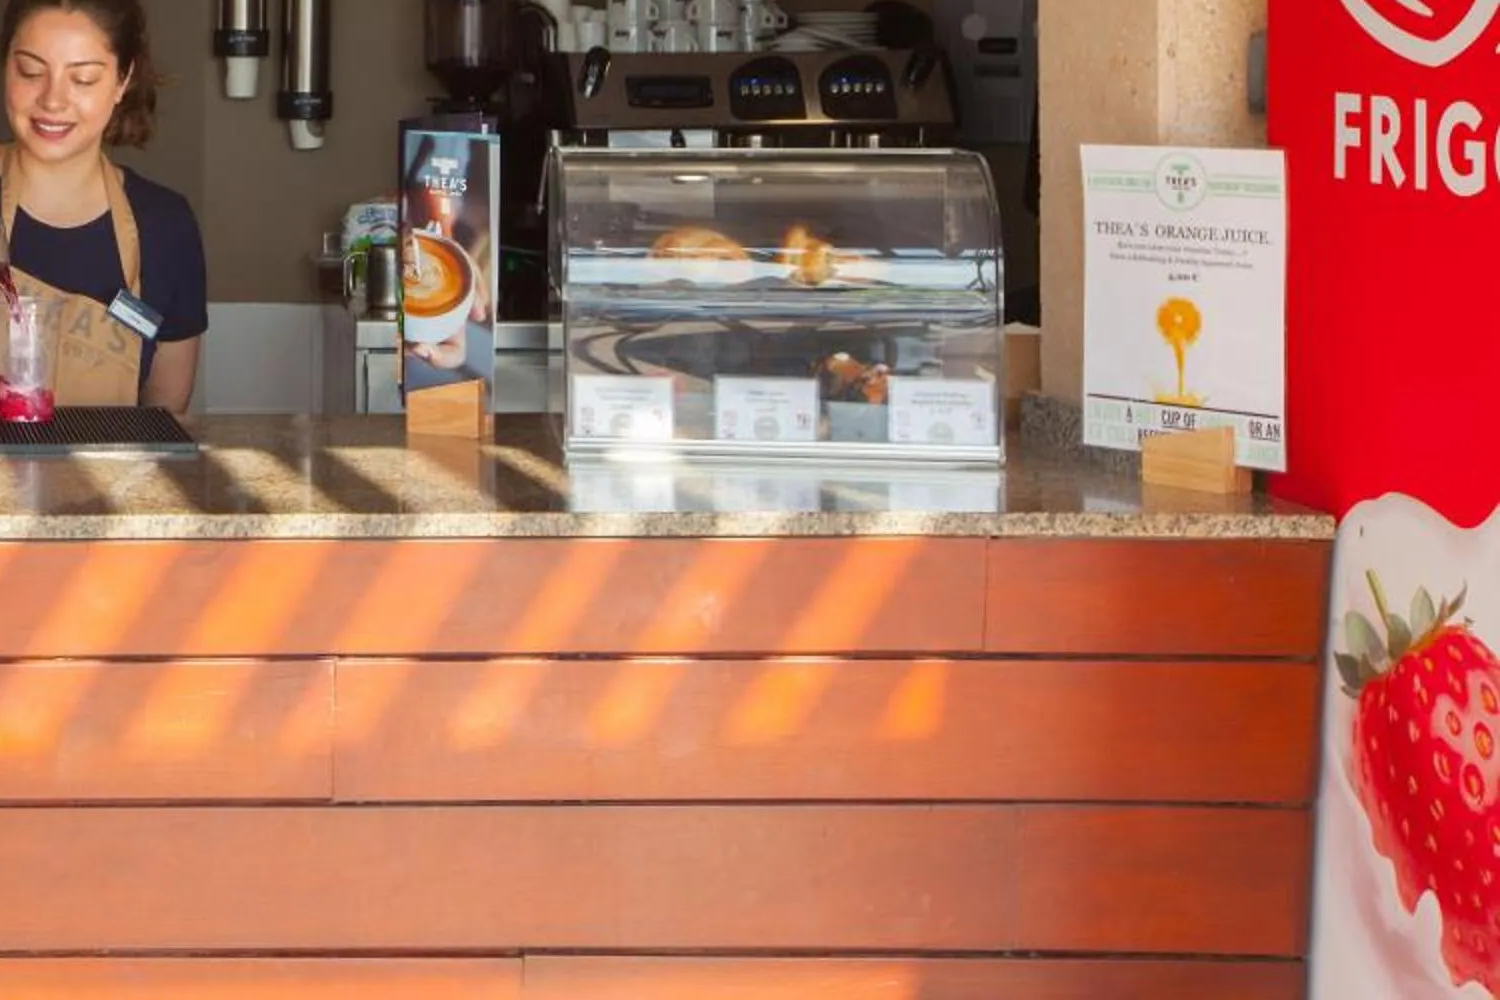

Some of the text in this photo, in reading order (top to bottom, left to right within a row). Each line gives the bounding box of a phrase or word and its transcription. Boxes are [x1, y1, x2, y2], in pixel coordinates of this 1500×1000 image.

[1333, 91, 1500, 197] FRIG
[1155, 223, 1218, 242] ORANGE
[1161, 409, 1181, 427] CUP
[1183, 412, 1197, 428] OF
[1249, 420, 1264, 438] OR
[1265, 422, 1281, 439] AN
